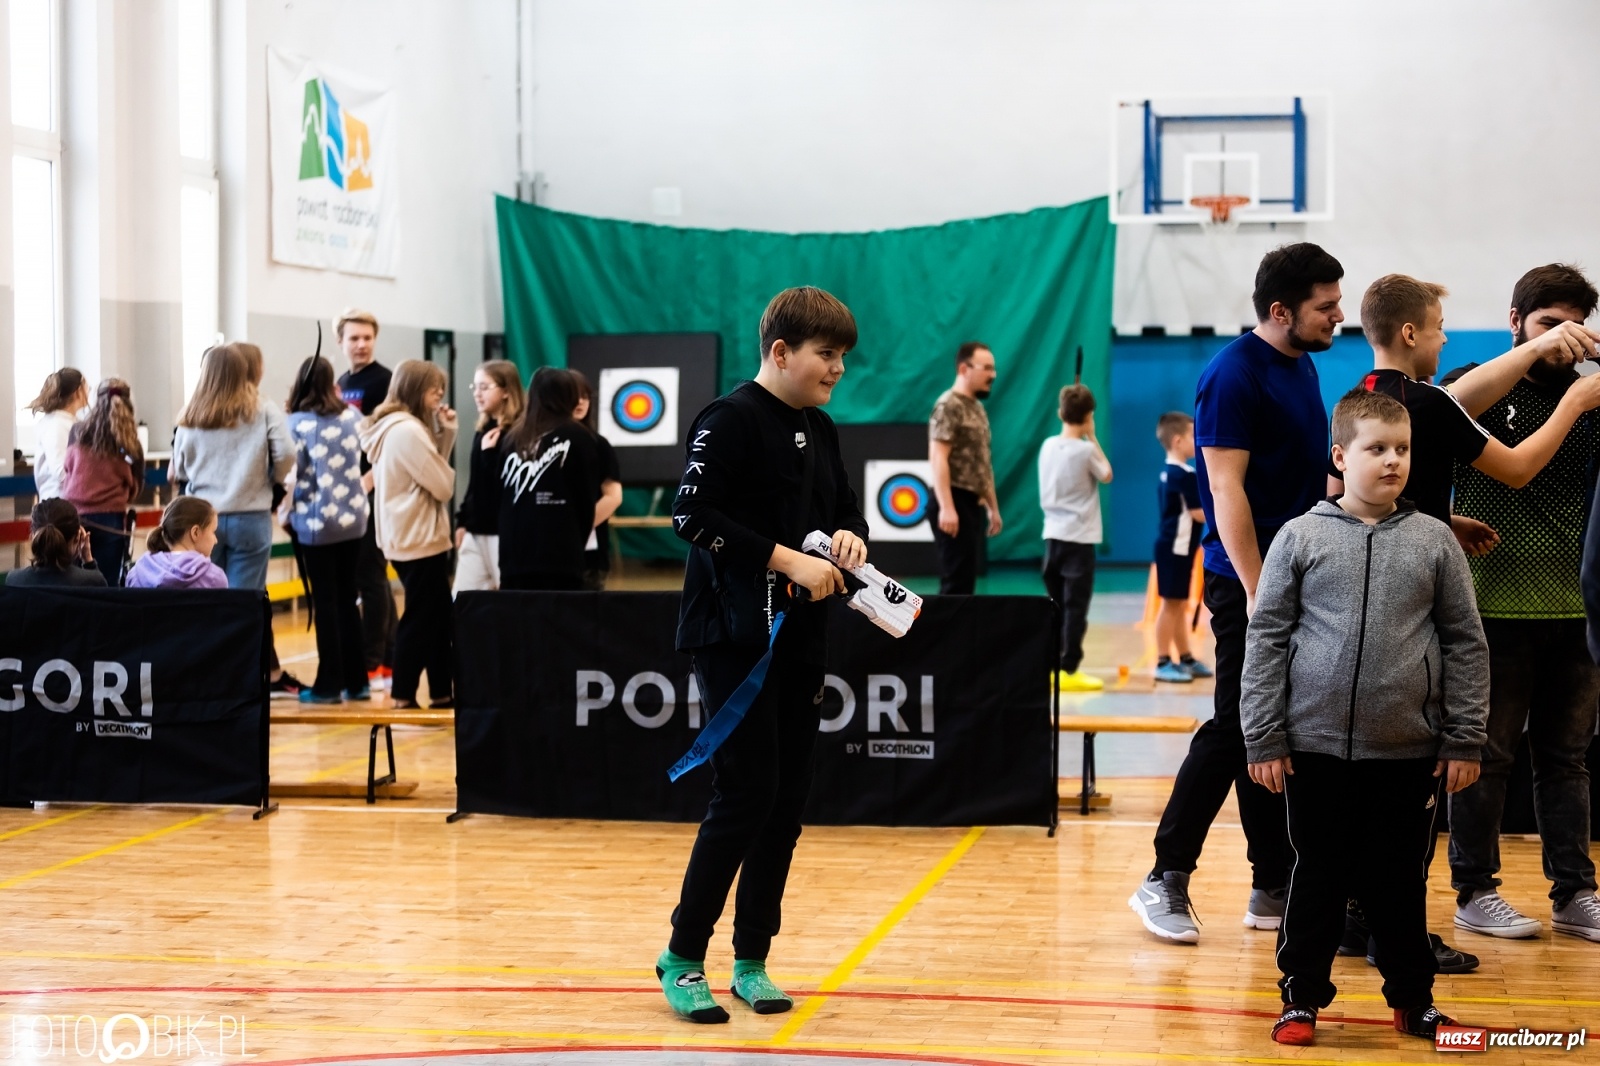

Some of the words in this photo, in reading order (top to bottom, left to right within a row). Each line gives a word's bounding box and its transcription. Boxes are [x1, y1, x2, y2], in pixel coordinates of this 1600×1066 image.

[678, 429, 711, 496] NIKE
[674, 514, 725, 553] AIR
[763, 568, 777, 635] Champion
[75, 722, 90, 732] BY
[846, 743, 862, 754] BY
[872, 744, 930, 755] DECATHLON
